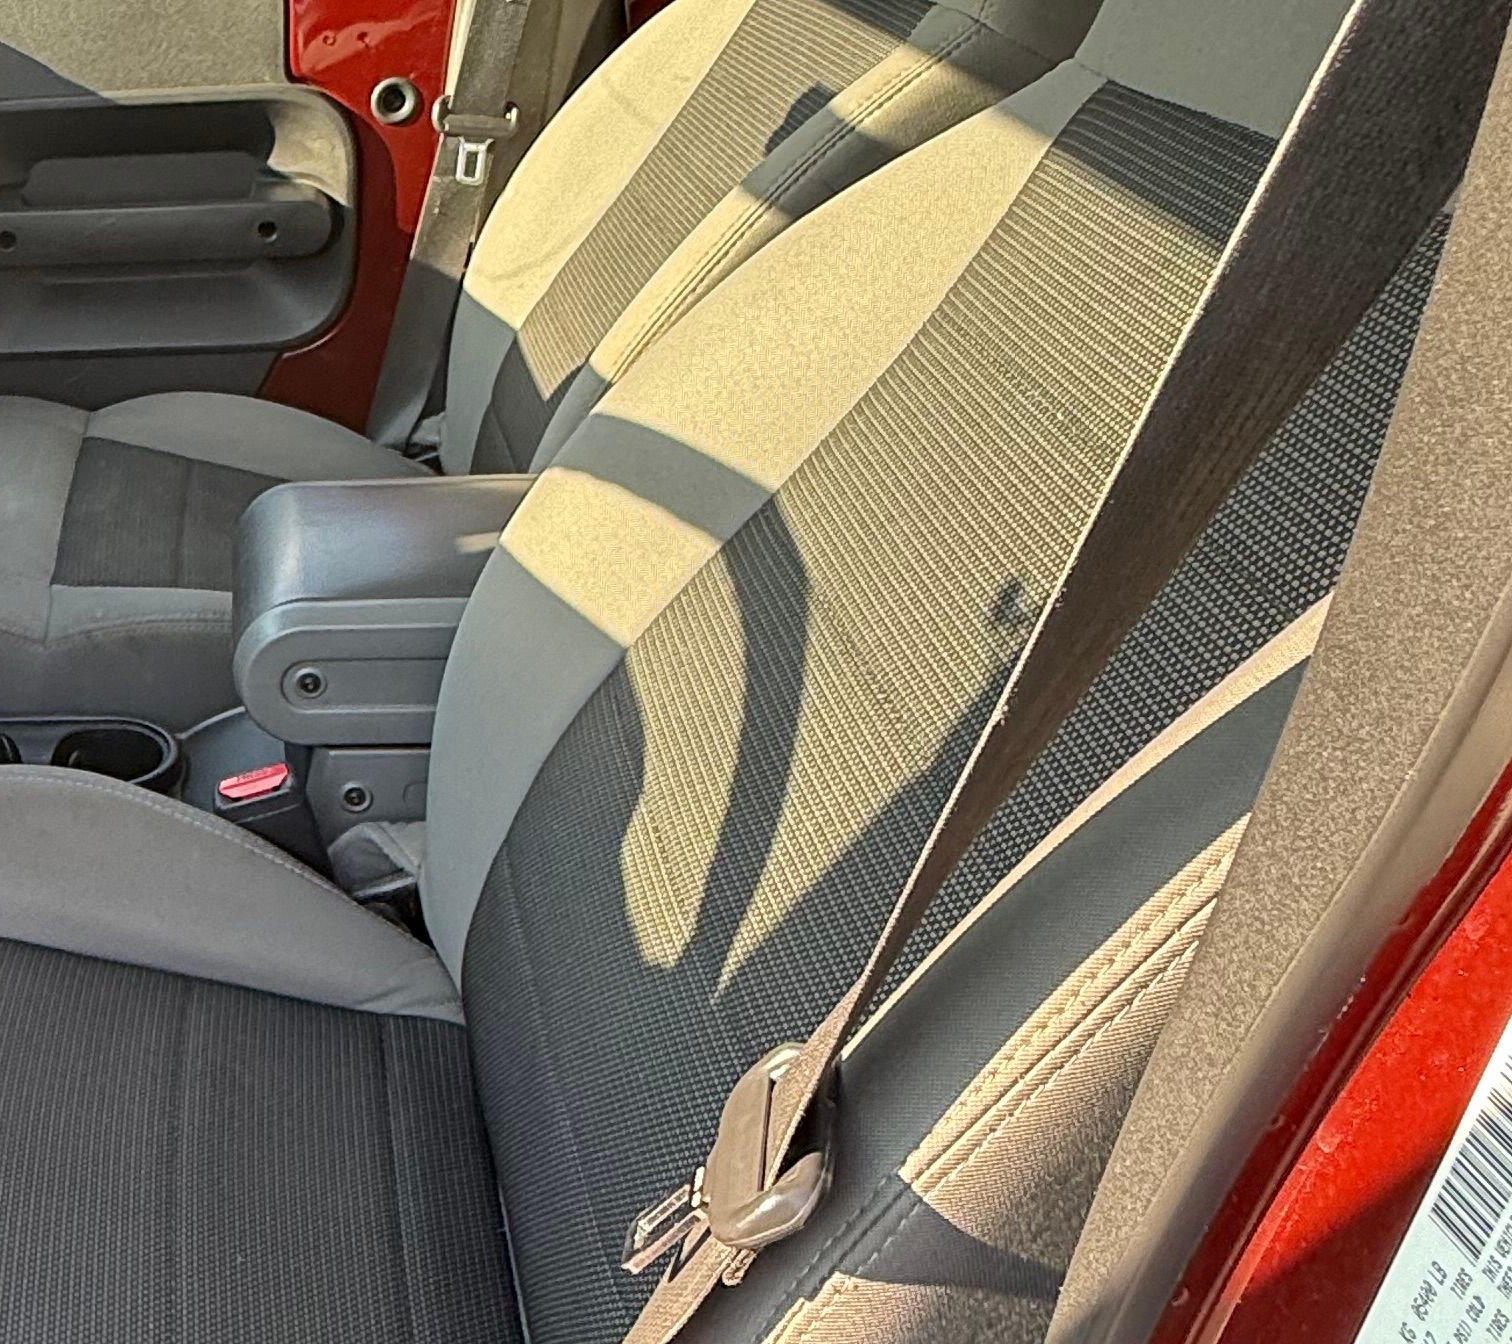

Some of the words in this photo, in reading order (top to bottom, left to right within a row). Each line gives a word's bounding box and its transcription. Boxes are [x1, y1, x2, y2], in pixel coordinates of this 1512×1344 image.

[1482, 1255, 1503, 1283] THIS
[1494, 1215, 1512, 1258] VEHIC
[1429, 1259, 1447, 1287] LB
[1452, 1266, 1472, 1301] TIRES
[1466, 1292, 1485, 1324] COLD
[1488, 1307, 1509, 1344] TIRES
